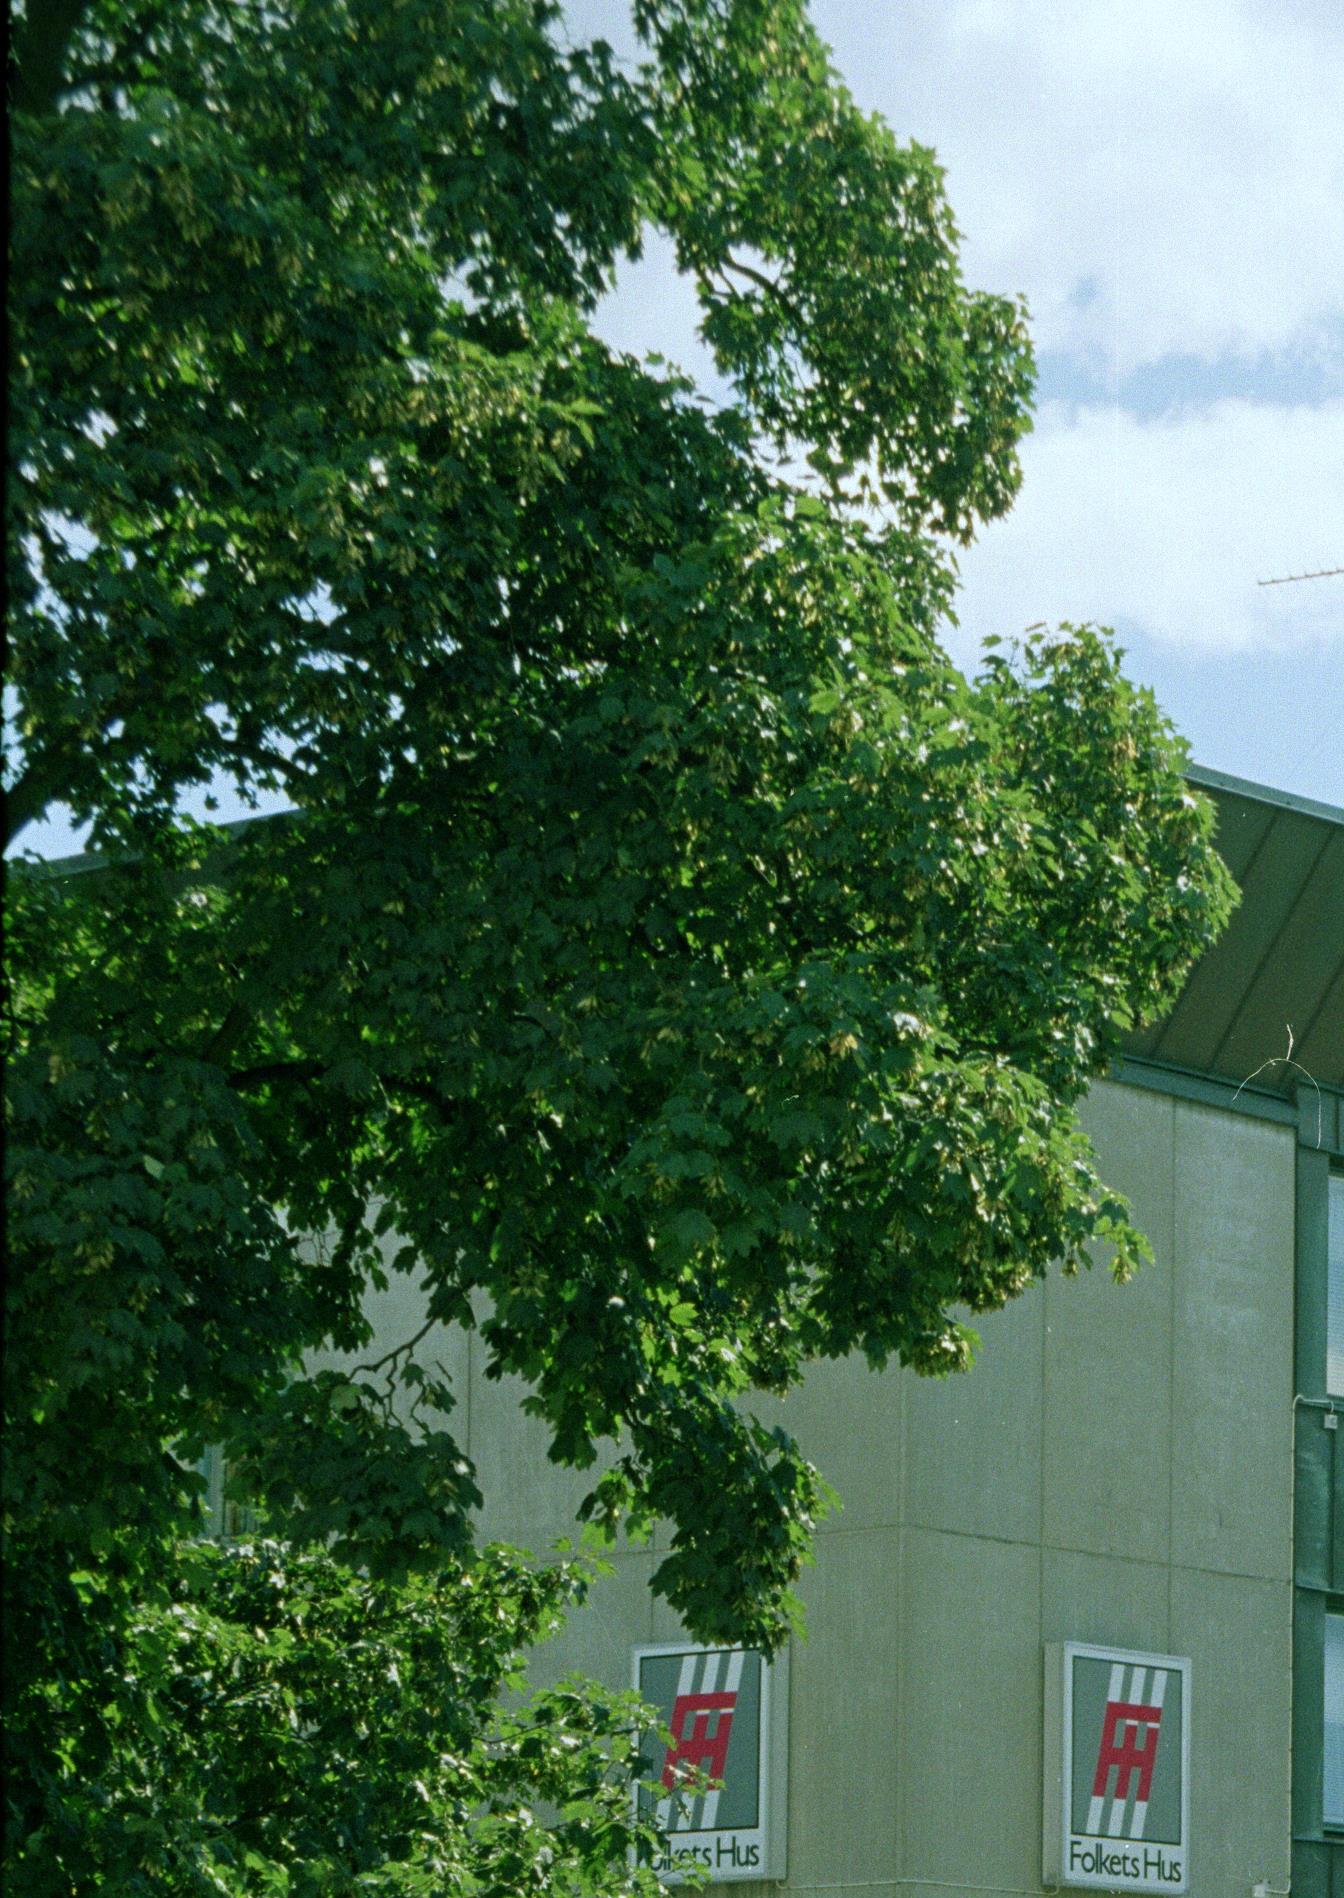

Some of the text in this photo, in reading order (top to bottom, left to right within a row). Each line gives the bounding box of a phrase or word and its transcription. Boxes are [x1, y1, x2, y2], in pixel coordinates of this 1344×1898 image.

[637, 1836, 760, 1871] olkets Hus
[1070, 1841, 1182, 1882] Folkets Hus
